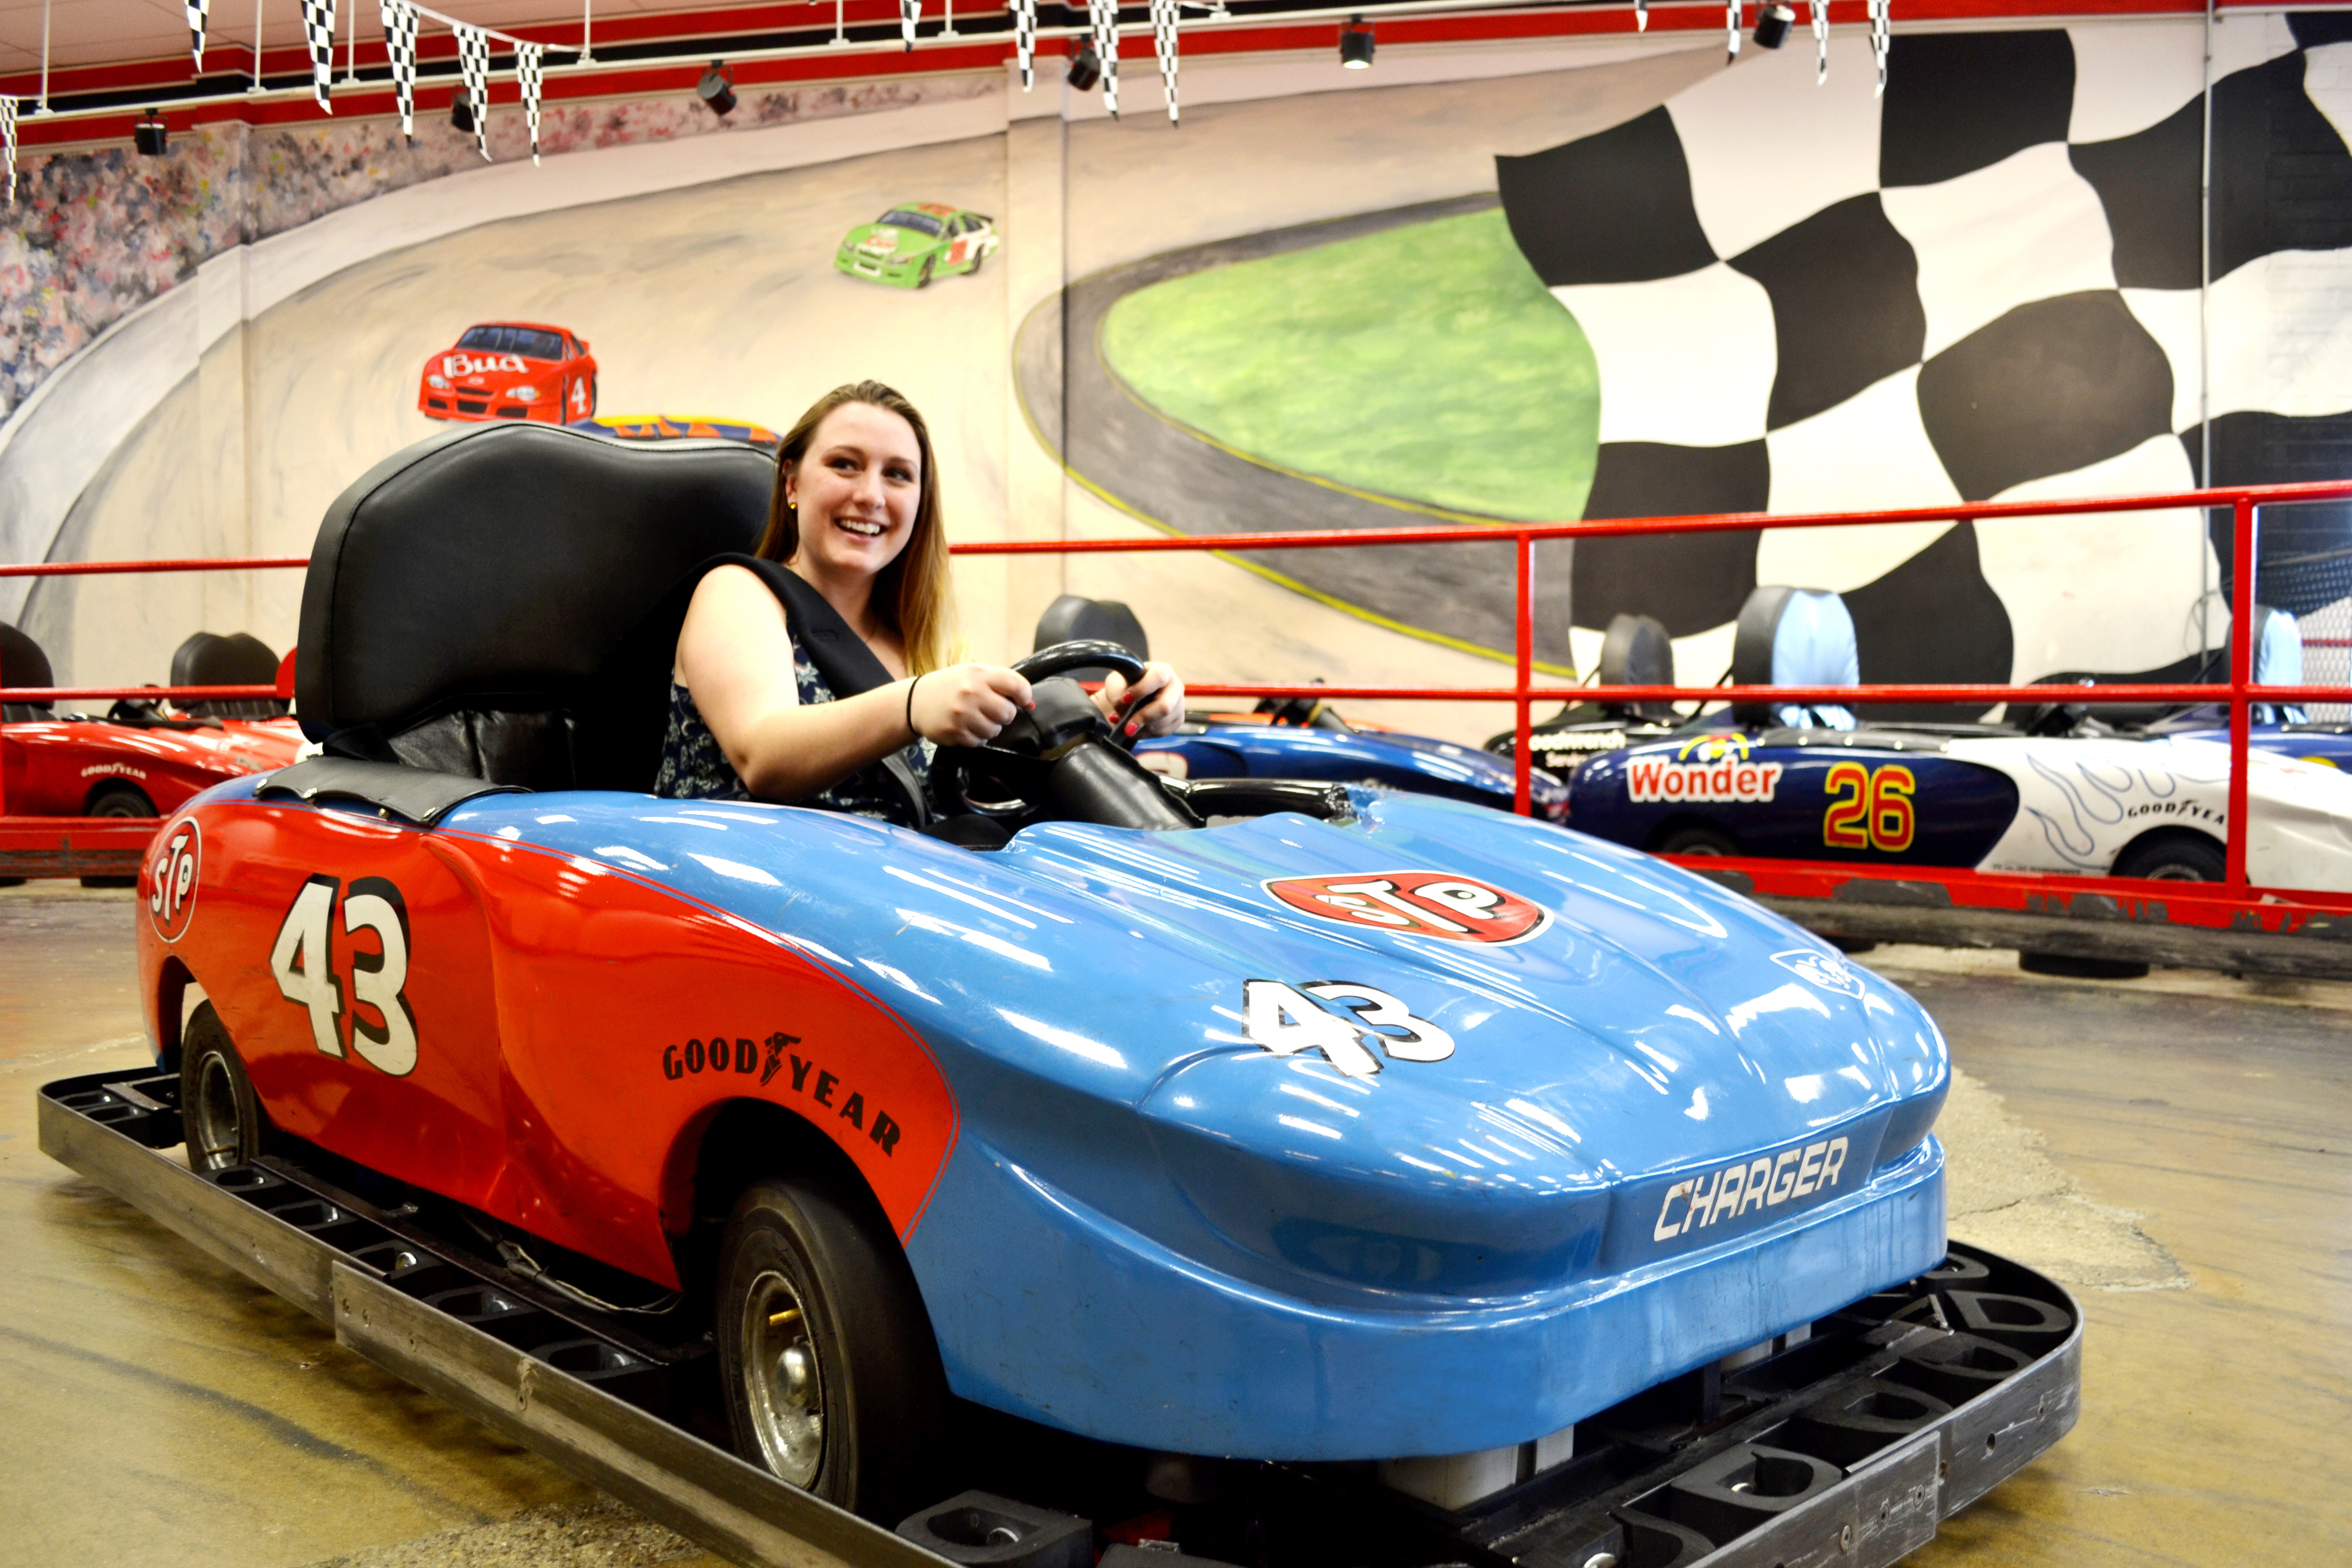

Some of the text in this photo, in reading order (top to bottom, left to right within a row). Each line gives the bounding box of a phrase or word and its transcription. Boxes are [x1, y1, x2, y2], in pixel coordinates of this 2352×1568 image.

[442, 354, 530, 378] Bud
[571, 376, 586, 414] 4
[1628, 756, 1781, 801] Wonder
[1824, 762, 1916, 852] 26
[2128, 800, 2225, 825] GOODYEA
[152, 834, 194, 927] STP
[1314, 879, 1507, 937] STP
[269, 873, 419, 1078] 43
[1241, 978, 1456, 1078] 43
[1653, 1136, 1848, 1242] CHARGER
